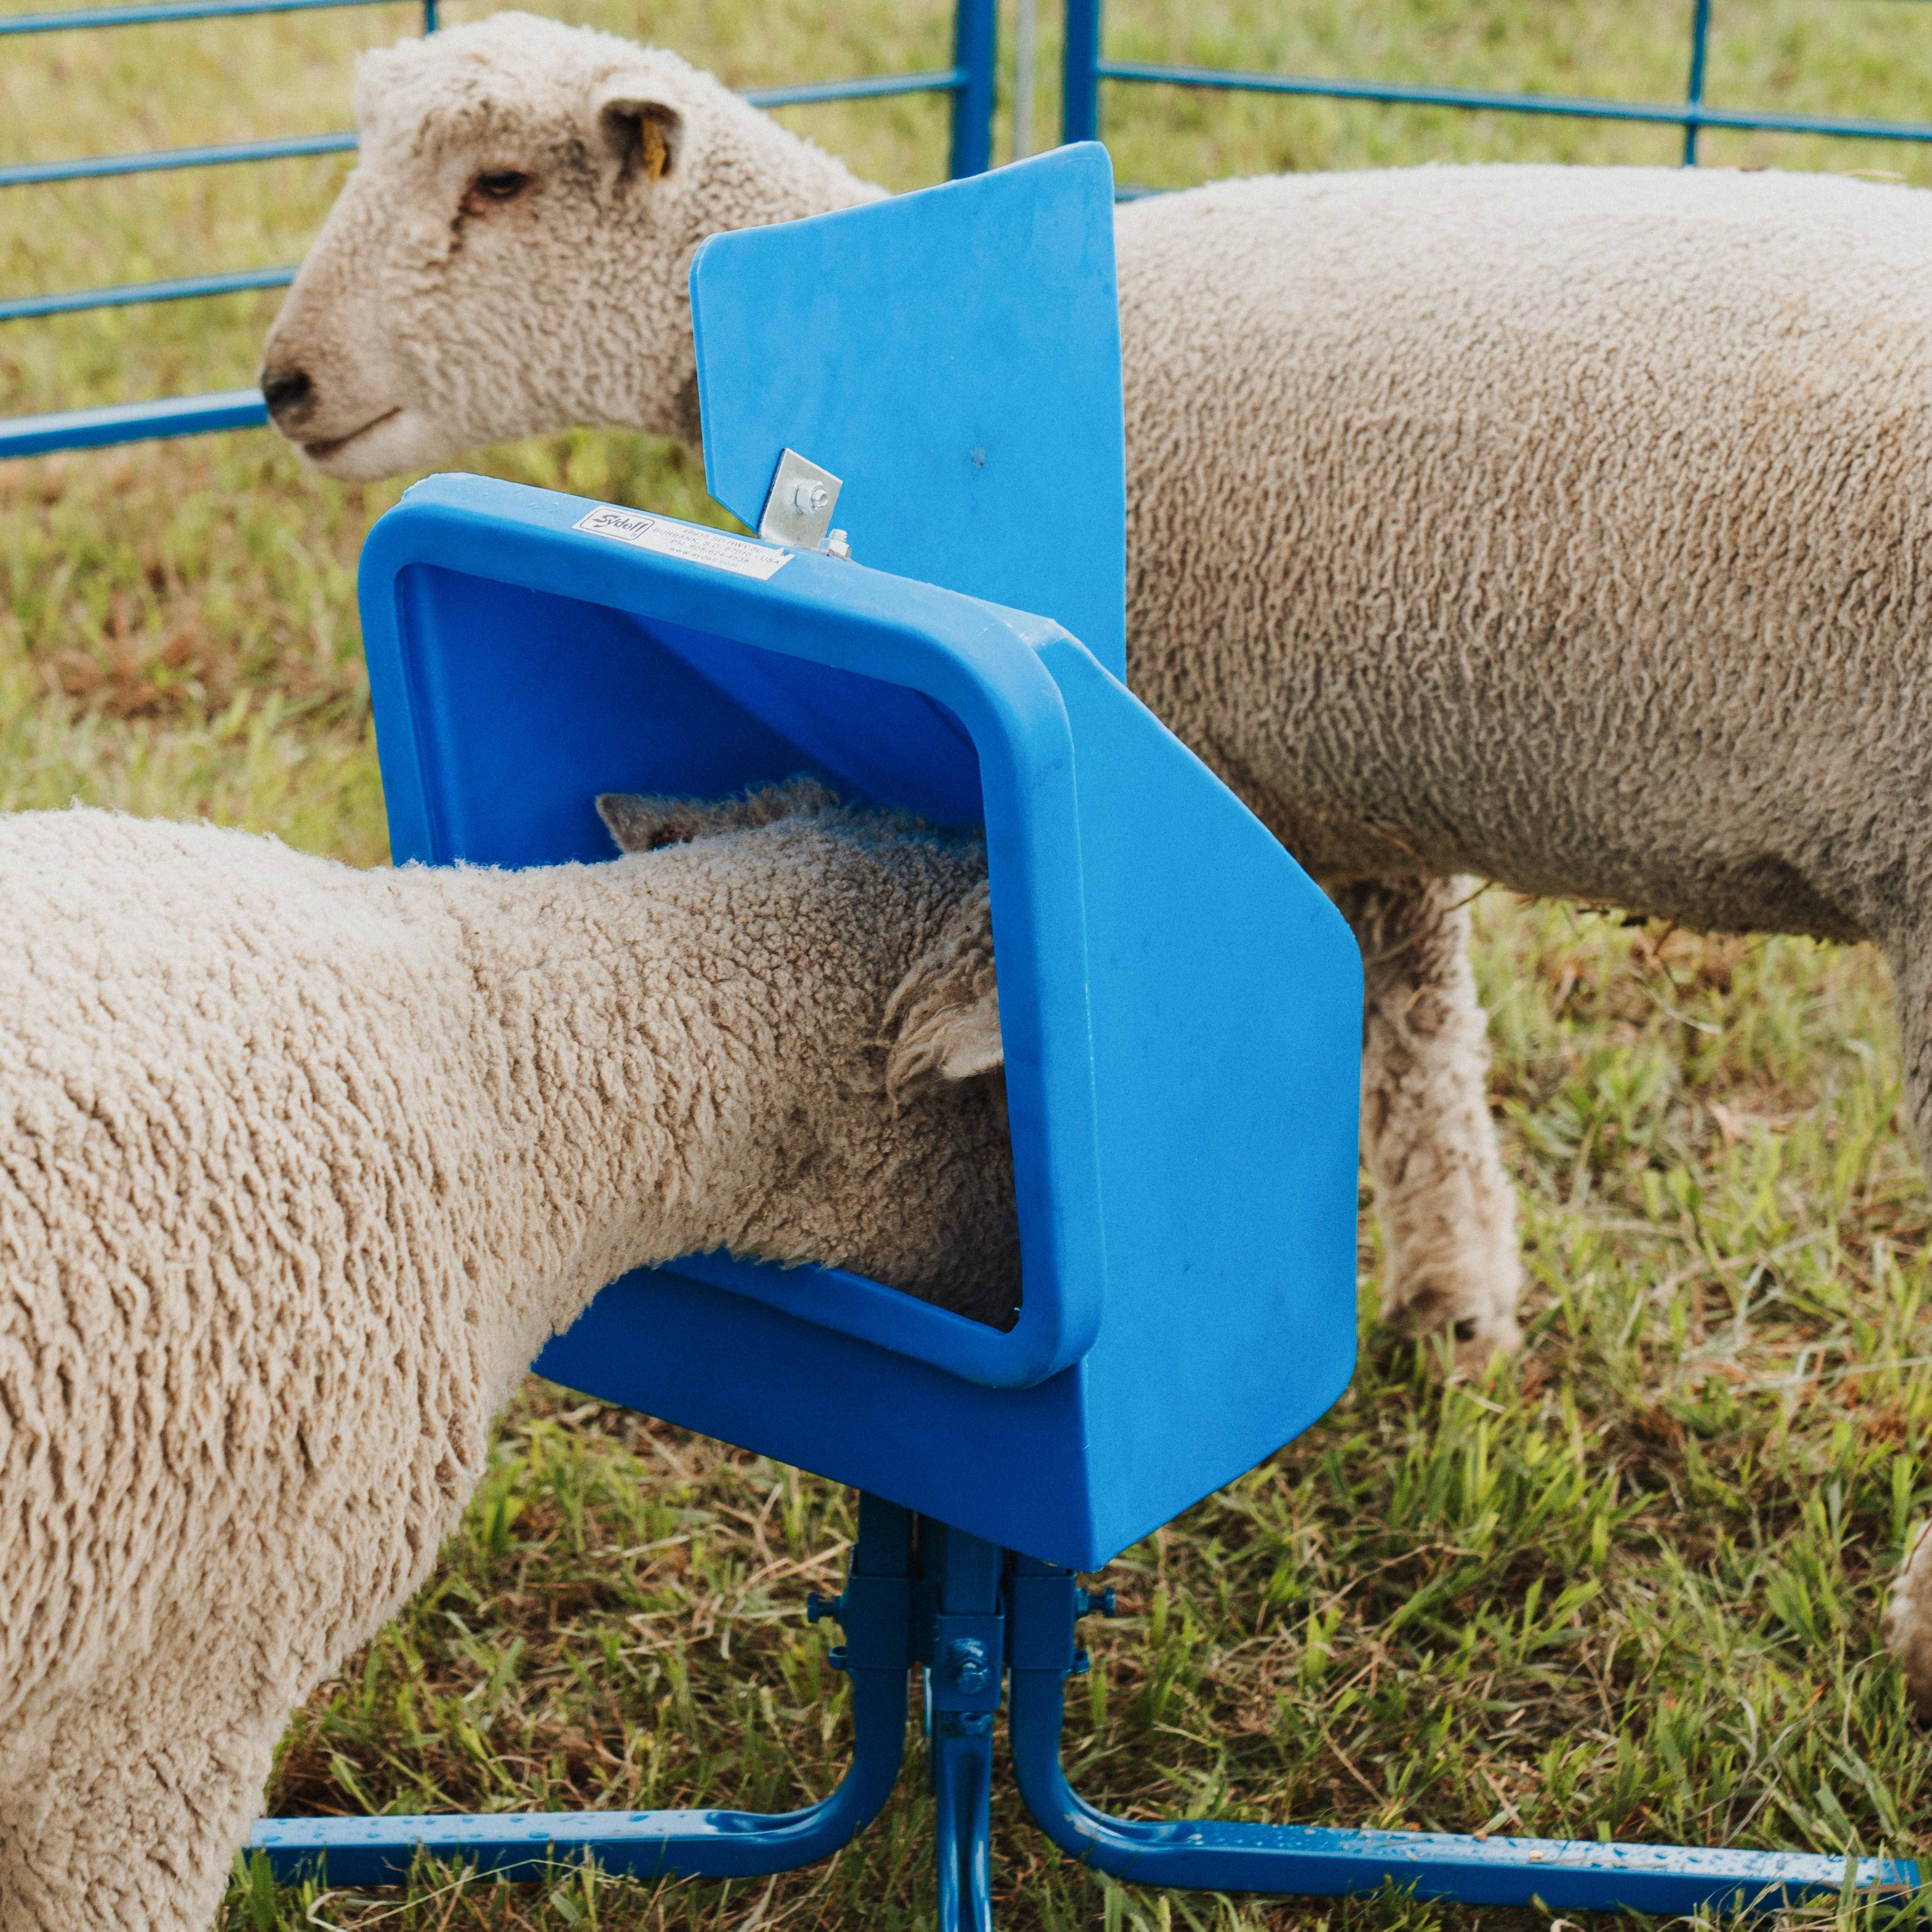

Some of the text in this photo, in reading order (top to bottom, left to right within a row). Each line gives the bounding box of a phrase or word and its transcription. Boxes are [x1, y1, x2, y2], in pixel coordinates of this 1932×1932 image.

[593, 514, 649, 532] Sydell
[727, 541, 750, 549] HWY
[760, 556, 779, 565] USA
